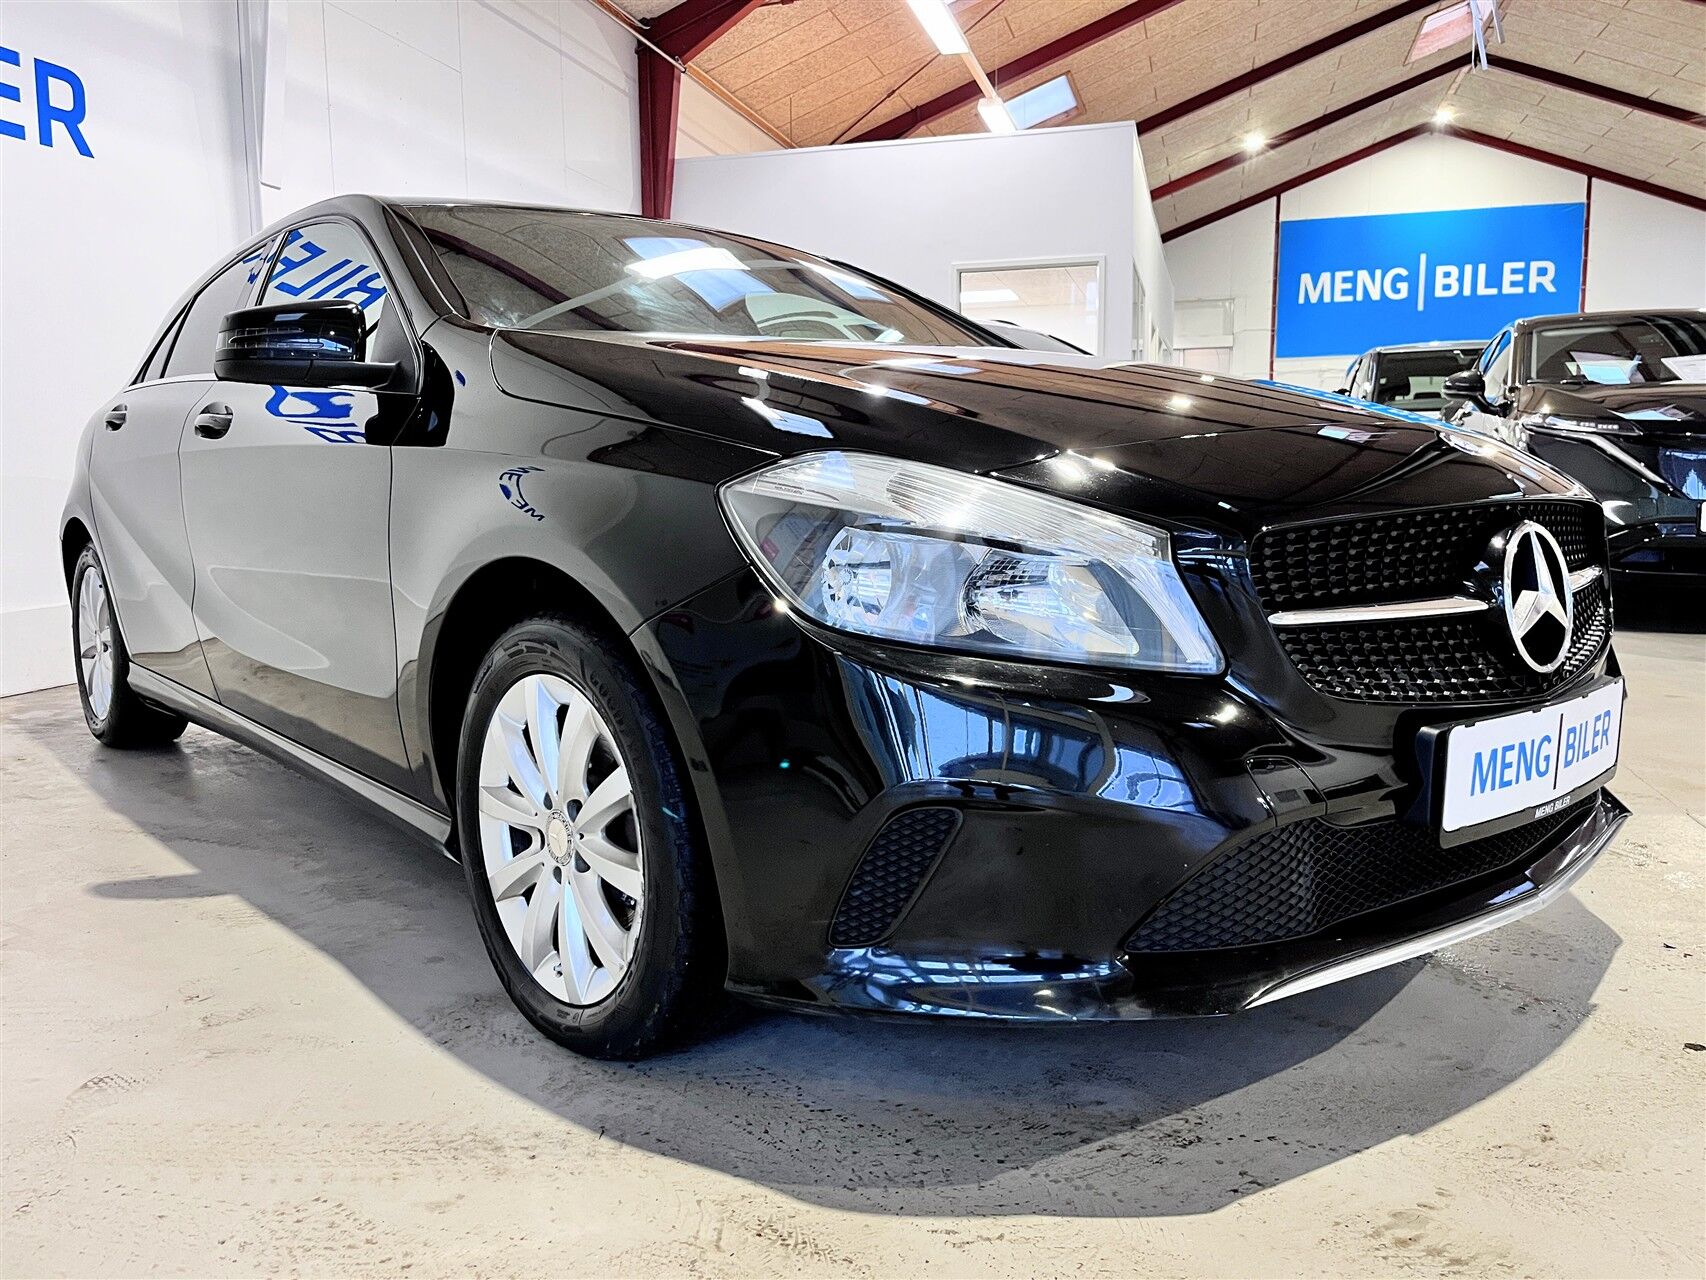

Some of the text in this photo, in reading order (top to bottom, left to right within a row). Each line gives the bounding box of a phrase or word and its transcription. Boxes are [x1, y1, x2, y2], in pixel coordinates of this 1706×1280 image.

[1297, 260, 1557, 304] MENG BILER
[1470, 709, 1611, 796] MENG BILER
[1534, 795, 1571, 819] MENG BILER
